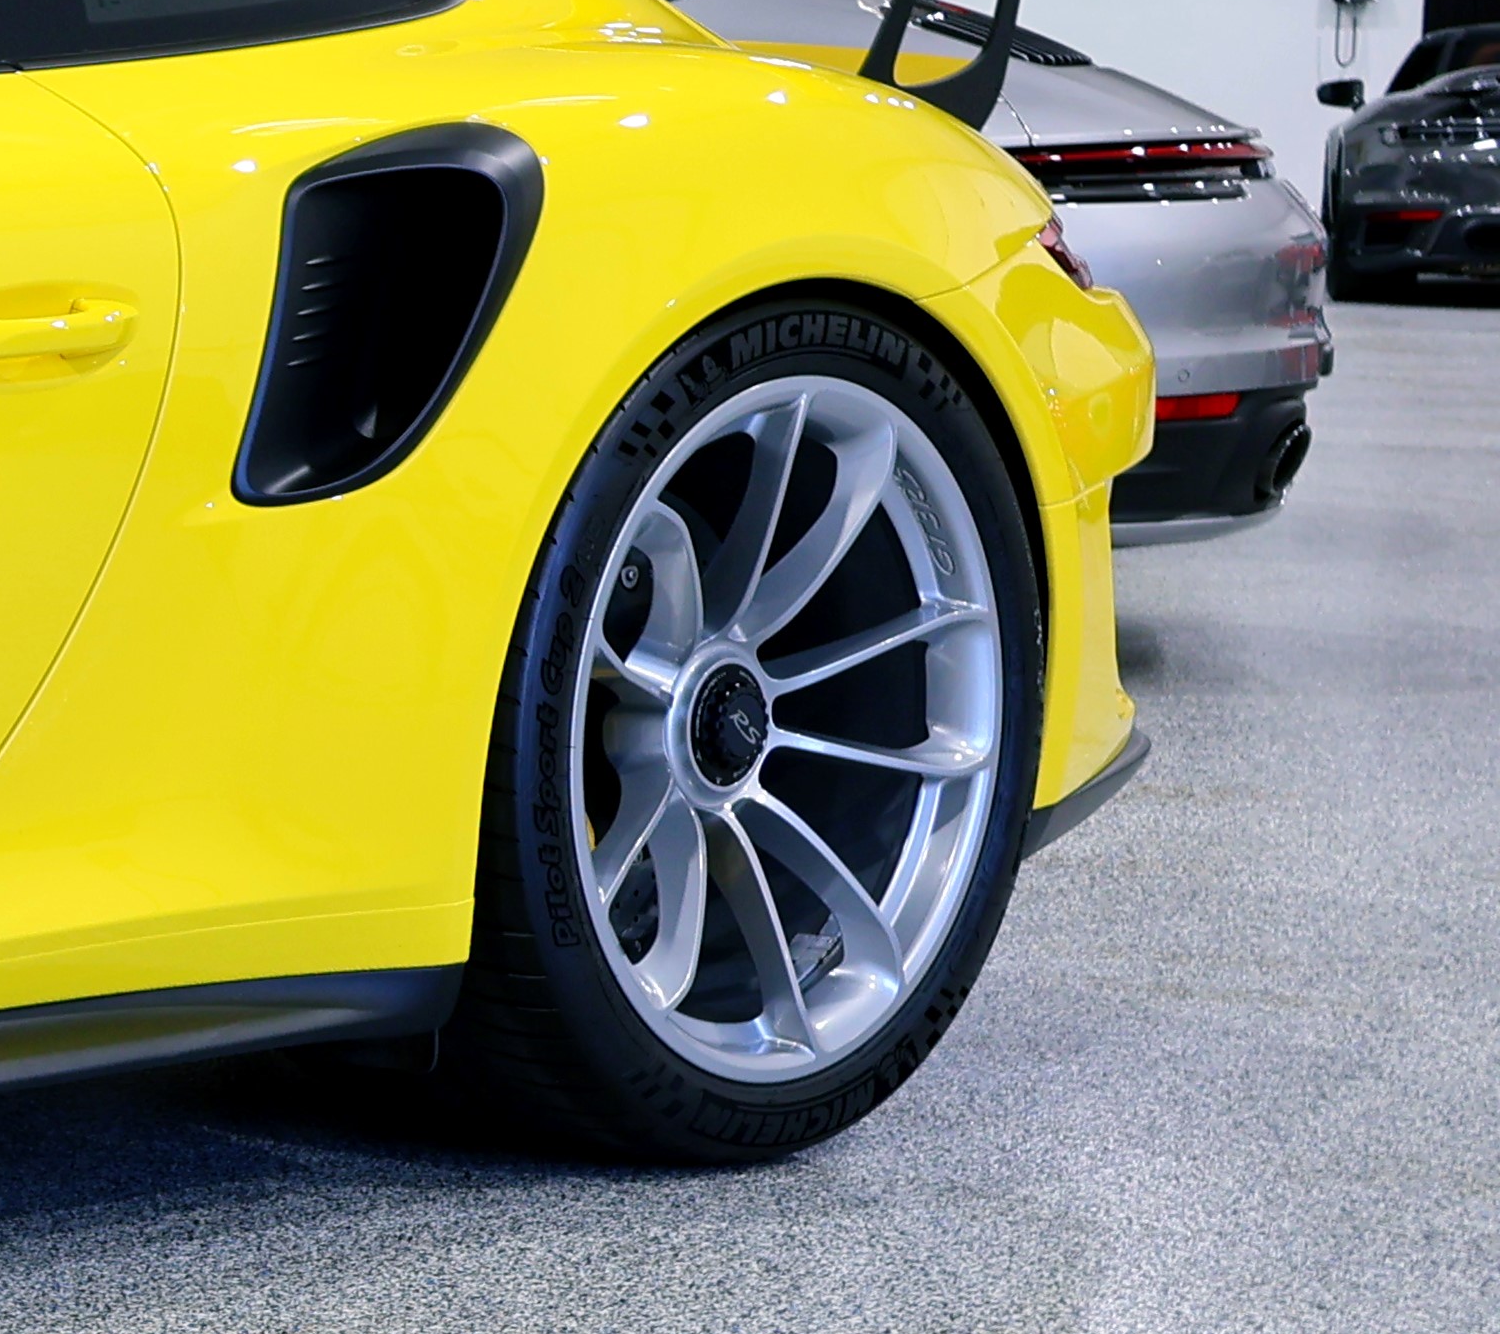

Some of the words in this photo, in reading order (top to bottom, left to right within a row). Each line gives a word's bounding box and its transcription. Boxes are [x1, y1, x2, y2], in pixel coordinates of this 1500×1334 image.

[730, 312, 908, 369] MICHELIN
[559, 565, 583, 608] 2
[540, 611, 574, 699] Cup
[729, 708, 762, 745] RS
[533, 700, 562, 838] Sport
[536, 844, 581, 950] Pilot
[691, 1077, 876, 1146] MICHELIN
